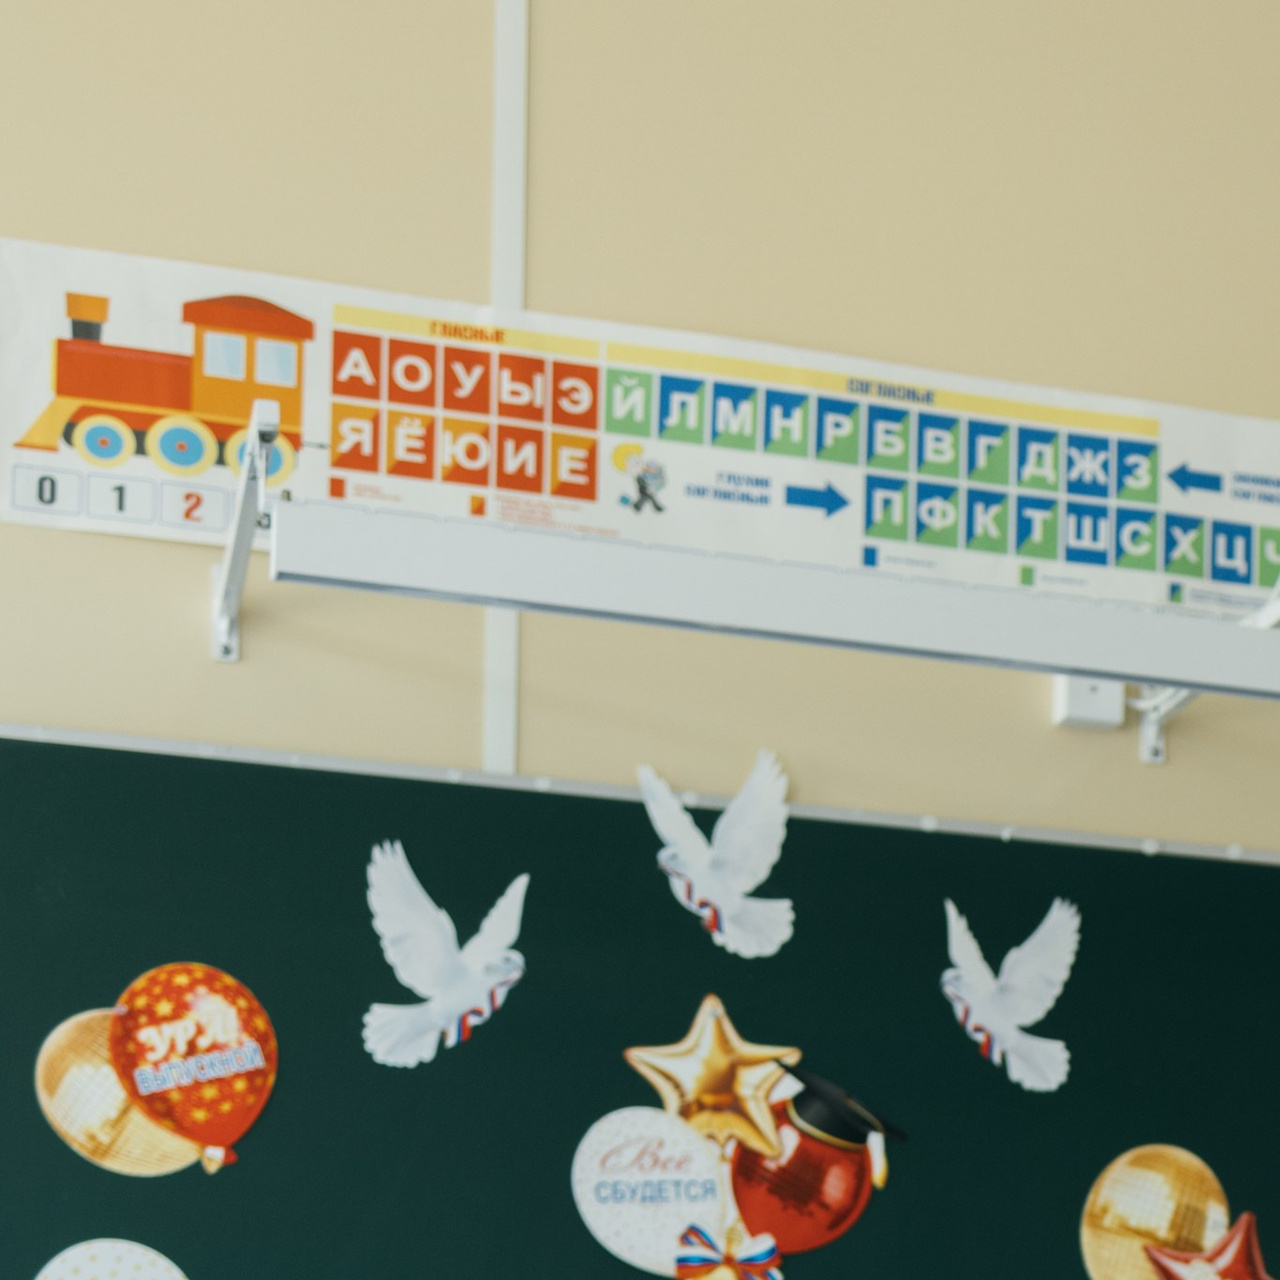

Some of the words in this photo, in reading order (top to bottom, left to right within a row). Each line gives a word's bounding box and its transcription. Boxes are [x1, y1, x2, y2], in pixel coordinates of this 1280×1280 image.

[336, 347, 376, 387] А
[391, 354, 433, 392] О
[450, 360, 485, 399] У
[499, 367, 545, 409] Ы
[557, 376, 594, 415] Э
[337, 417, 375, 457] Я
[393, 416, 428, 465] Ё
[441, 429, 491, 471] Ю
[502, 437, 538, 478] И
[557, 445, 591, 486] Е
[611, 374, 646, 423] Й
[662, 390, 699, 431] Л
[715, 396, 754, 437] М
[770, 403, 804, 444] Н
[823, 411, 855, 449] Р
[873, 419, 906, 457] Б
[923, 426, 956, 464] В
[975, 434, 1004, 470] Г
[1020, 441, 1057, 486] Д
[1067, 445, 1110, 486] Ж
[1122, 453, 1152, 490] З
[37, 475, 57, 504] 0
[112, 484, 127, 512] 1
[182, 491, 204, 522] 2
[872, 487, 905, 525] П
[918, 495, 957, 530] Ф
[972, 501, 1001, 539] К
[1021, 507, 1053, 543] Т
[1066, 512, 1109, 553] Ш
[1118, 520, 1153, 556] С
[1168, 525, 1199, 564] Х
[1214, 532, 1249, 578] Ц
[133, 1038, 266, 1096] ВЫПУСКНОЙ
[593, 1179, 718, 1204] СБУДЕТСЯ
